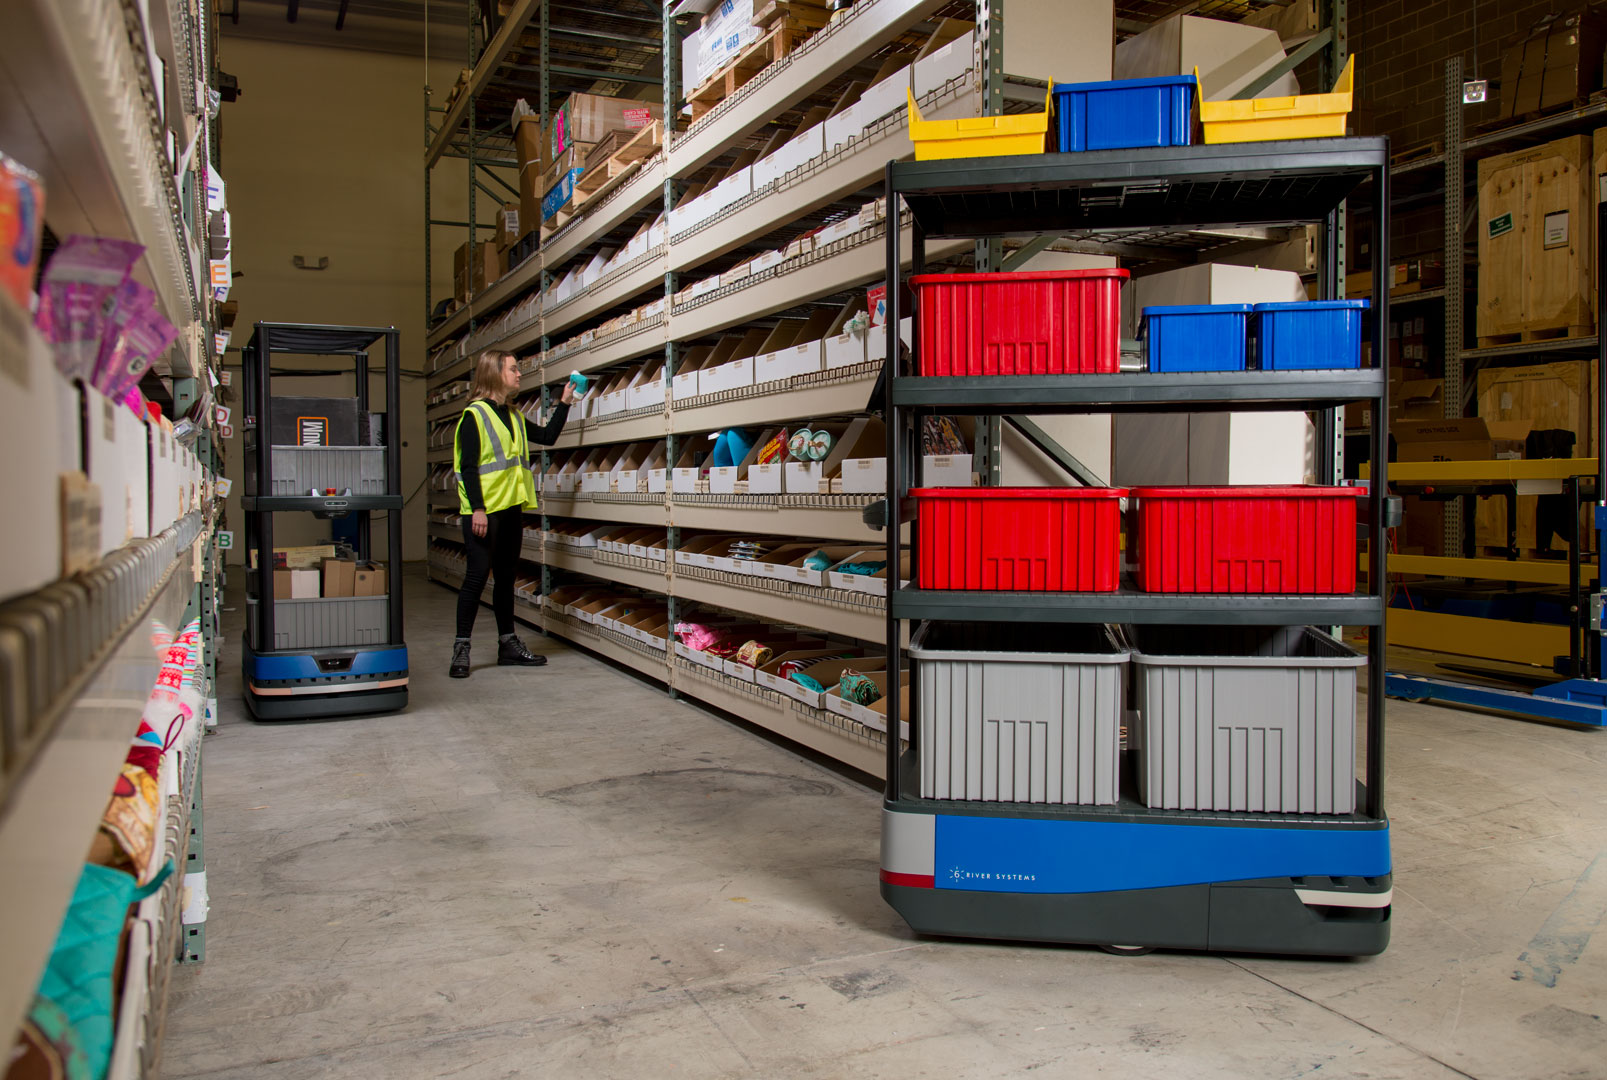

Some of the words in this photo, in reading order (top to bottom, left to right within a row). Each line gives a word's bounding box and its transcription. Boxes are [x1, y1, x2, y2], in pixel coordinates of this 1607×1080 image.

[211, 264, 228, 284] E
[216, 408, 227, 422] D
[222, 425, 232, 437] D
[217, 481, 228, 494] C
[218, 534, 231, 547] B
[966, 872, 991, 880] RIVER
[996, 873, 1036, 881] SYSTEMS
